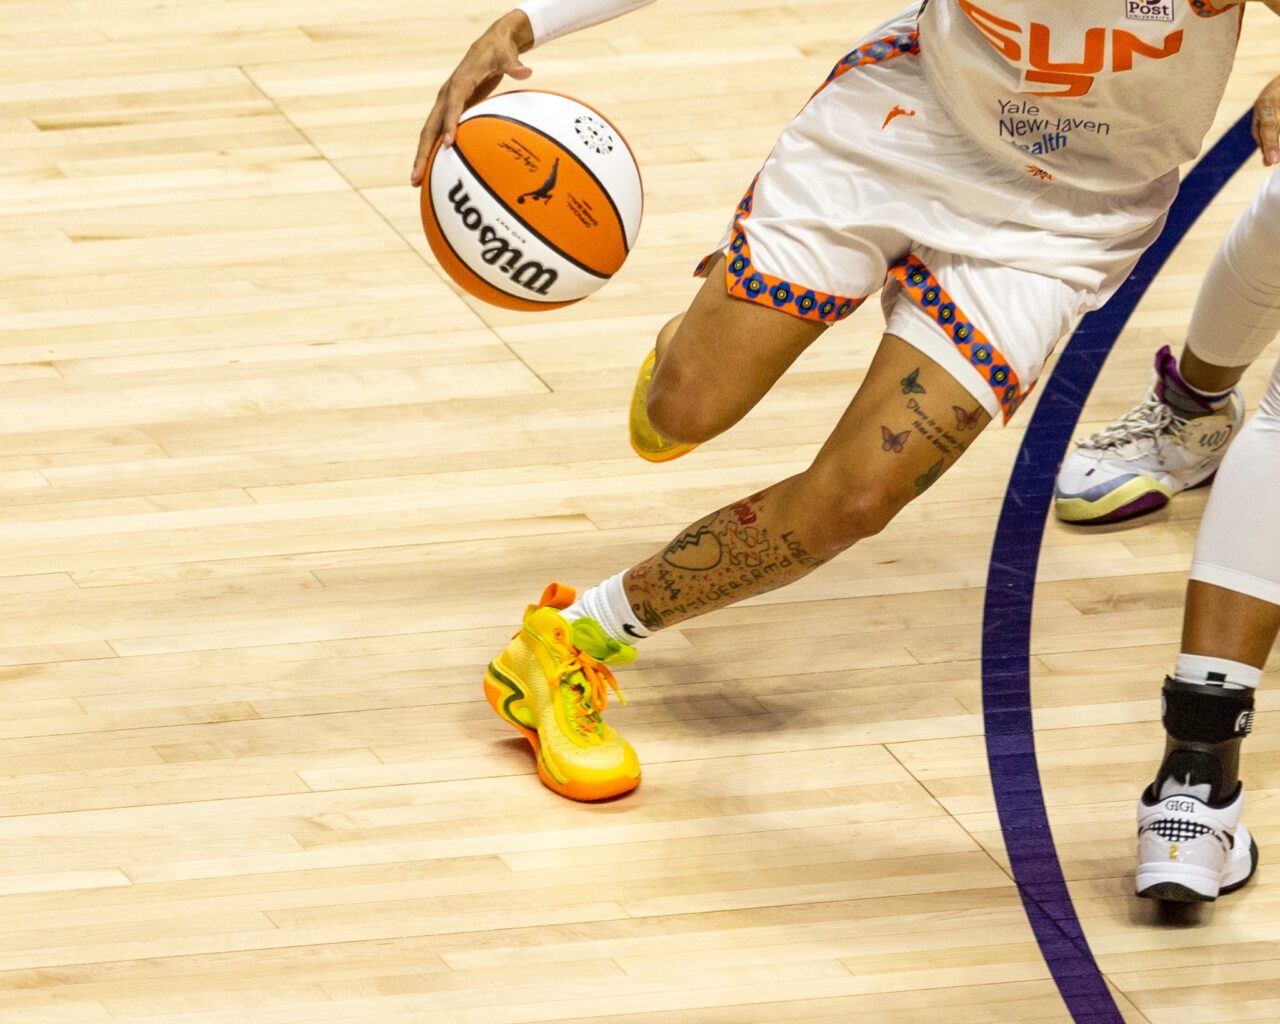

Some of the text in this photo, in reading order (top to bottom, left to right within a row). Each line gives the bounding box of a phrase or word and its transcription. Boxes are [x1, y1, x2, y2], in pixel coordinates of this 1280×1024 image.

[1129, 1, 1170, 16] Post
[998, 99, 1040, 116] Yale
[1009, 131, 1067, 155] ealth
[448, 177, 559, 295] Wilson
[1165, 800, 1195, 813] GIGI
